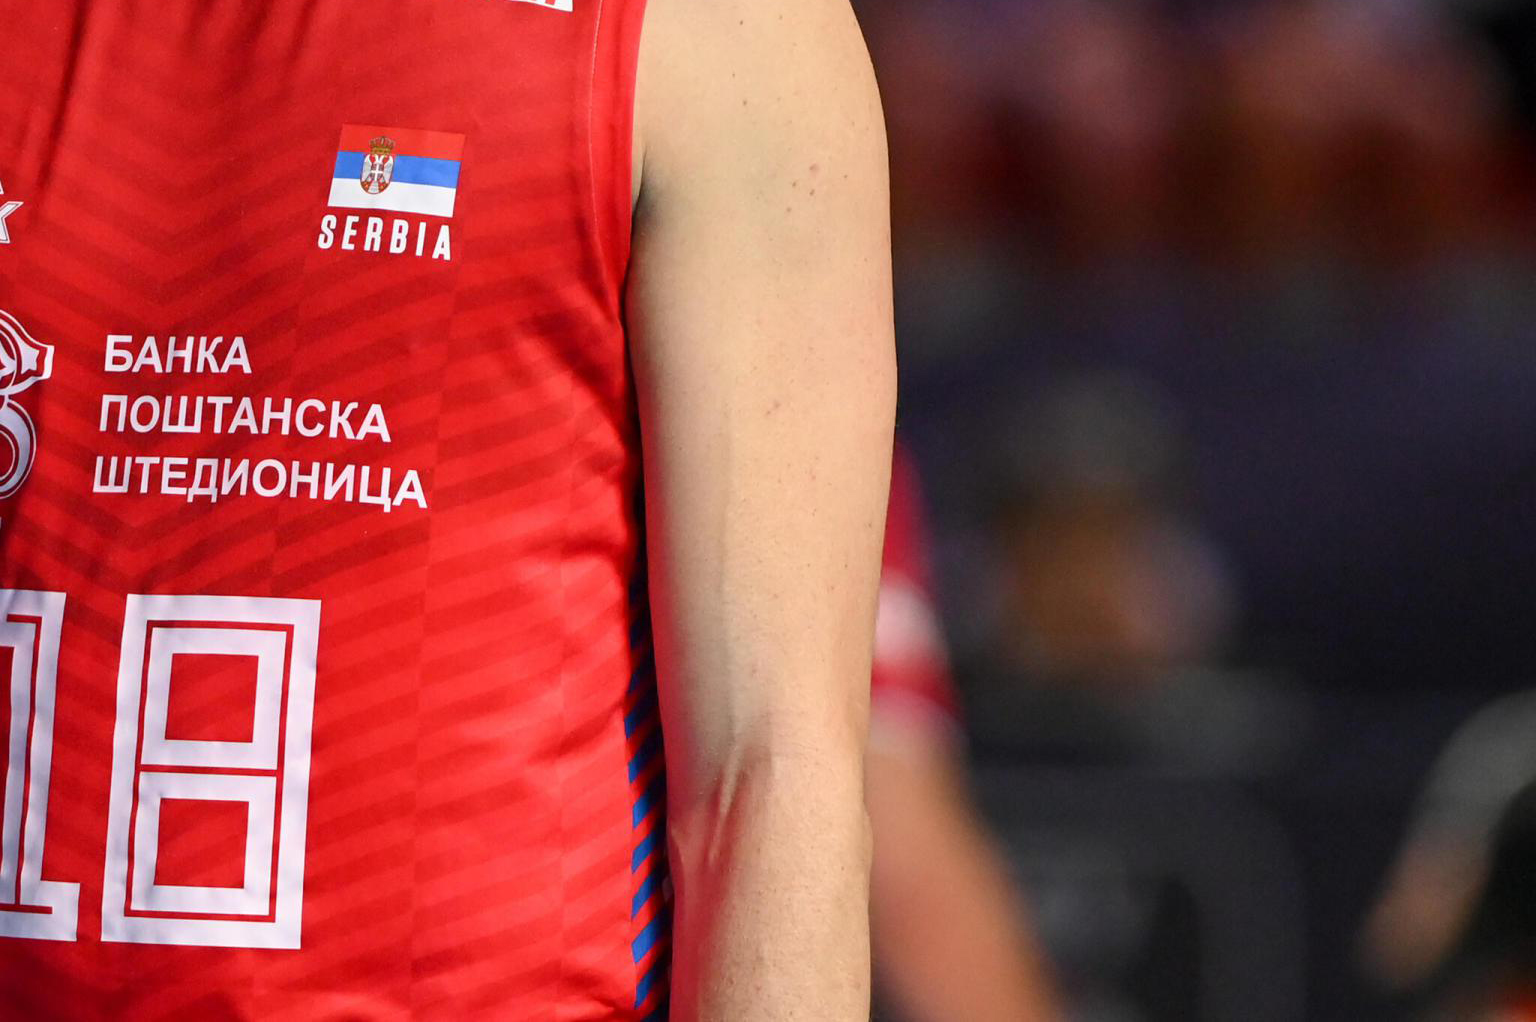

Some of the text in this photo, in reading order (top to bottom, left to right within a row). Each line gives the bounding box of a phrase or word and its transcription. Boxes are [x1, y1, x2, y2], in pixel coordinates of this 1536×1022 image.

[317, 214, 453, 261] SERBIA
[104, 334, 253, 374] БАНКА
[99, 394, 392, 443] ПОШТАНСКА
[92, 456, 428, 513] ШТЕДИОНИЦА
